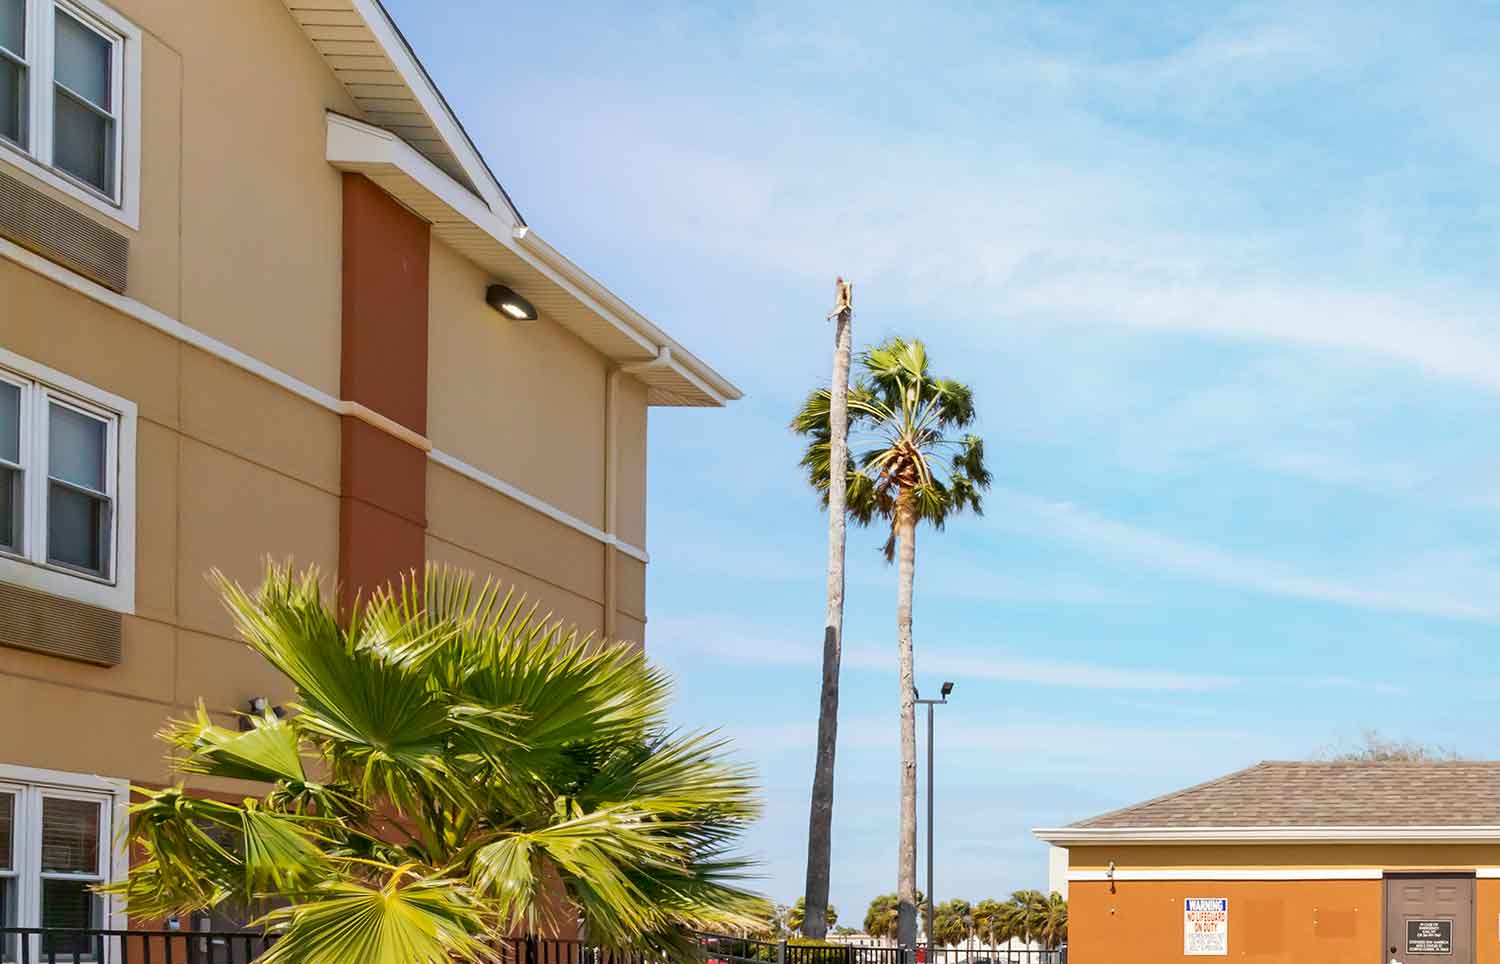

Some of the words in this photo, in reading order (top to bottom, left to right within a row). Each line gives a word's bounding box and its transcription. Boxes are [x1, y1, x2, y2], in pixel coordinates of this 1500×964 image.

[1189, 899, 1223, 911] WARNING
[1187, 912, 1195, 922] NO
[1196, 912, 1225, 922] LIFEGUARD
[1195, 922, 1203, 932] ON
[1204, 922, 1217, 932] DUTY
